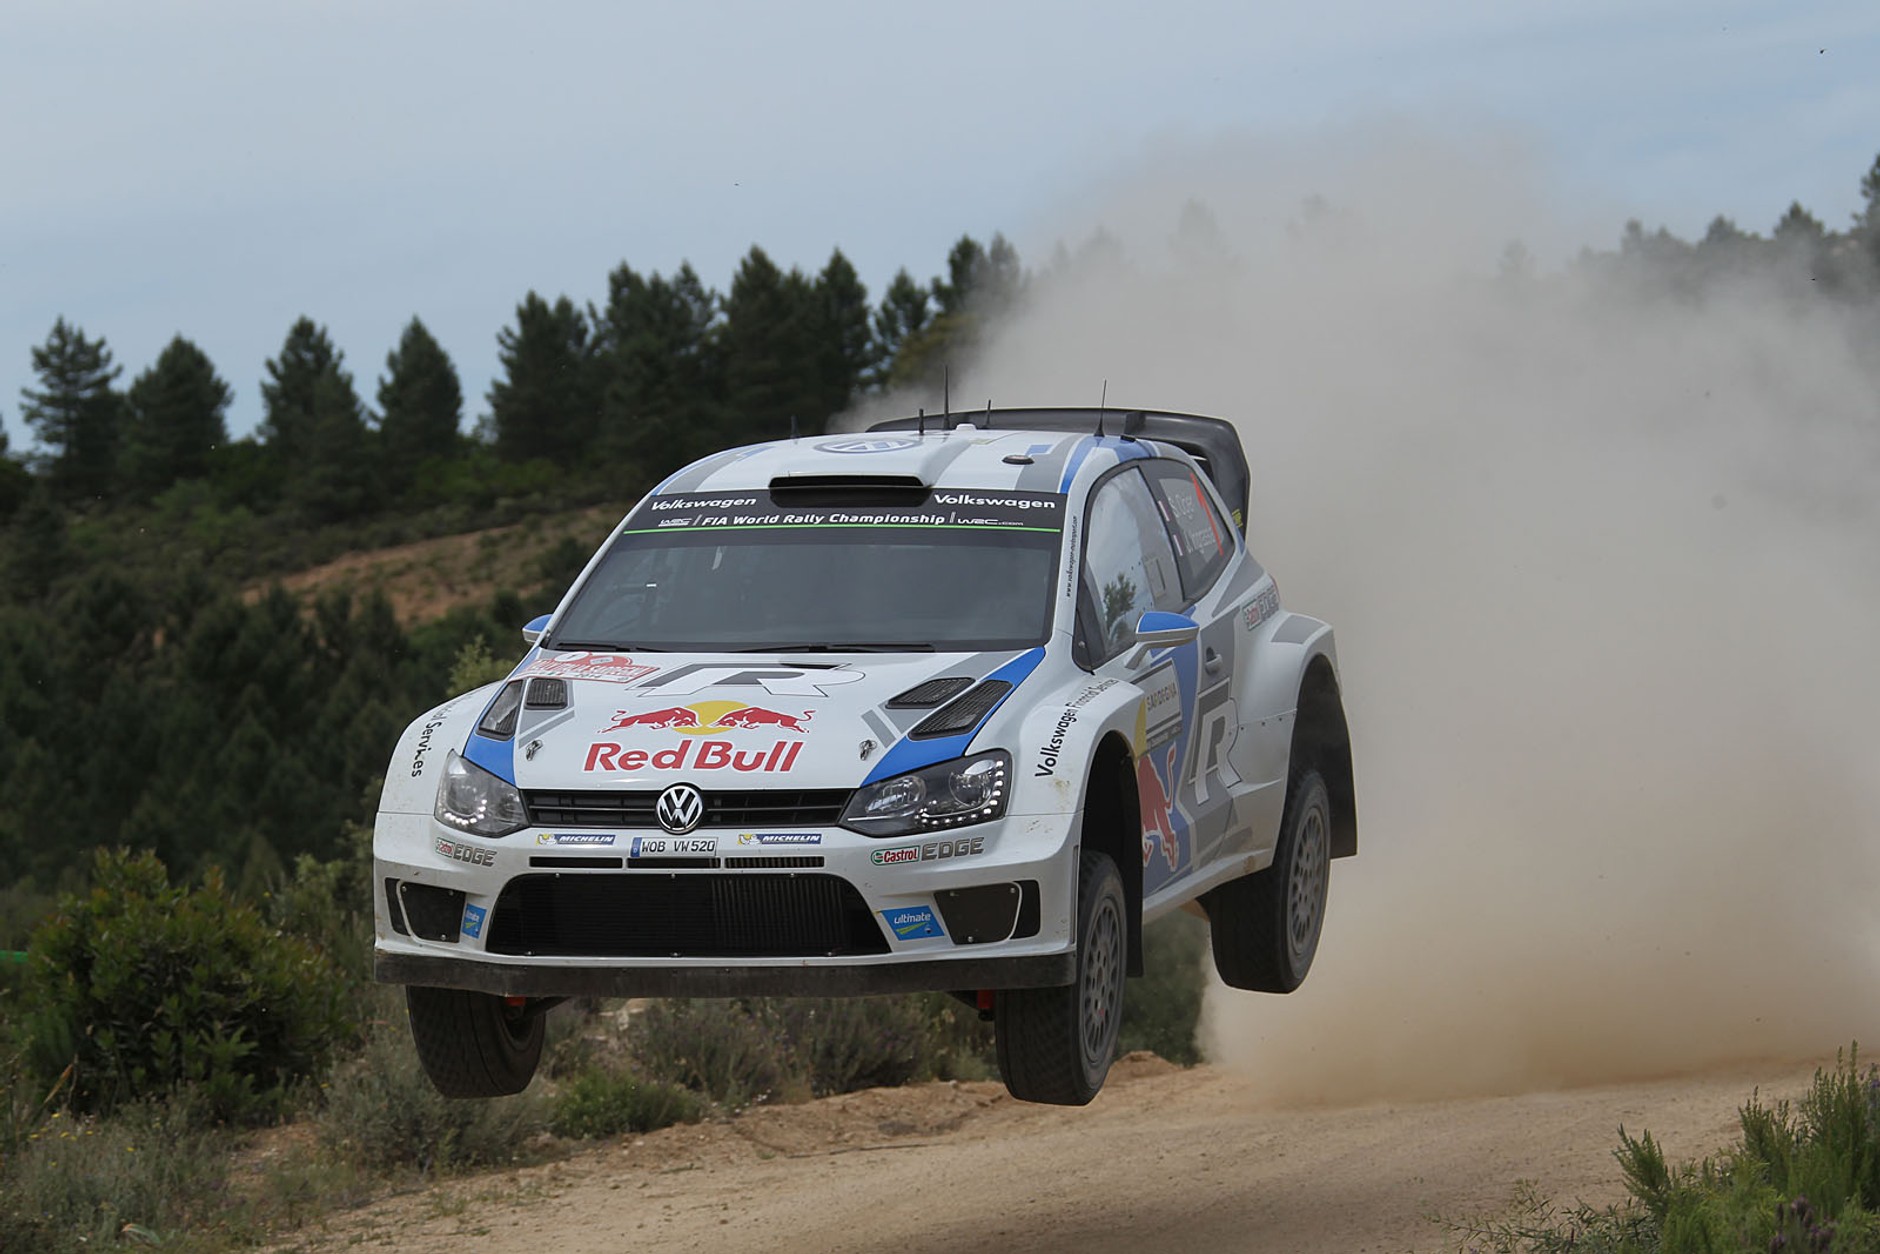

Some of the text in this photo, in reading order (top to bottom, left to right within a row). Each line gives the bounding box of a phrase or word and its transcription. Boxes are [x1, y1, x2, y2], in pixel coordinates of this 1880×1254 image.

[651, 498, 757, 511] Volkswagen
[934, 494, 1056, 509] Volkswagen
[701, 516, 727, 526] FIA
[733, 514, 780, 525] World
[783, 514, 825, 525] Rally
[829, 513, 945, 525] Championship
[583, 740, 804, 772] Red Bull
[558, 835, 614, 843] MICHELIN
[762, 834, 821, 843] MICHELIN
[642, 841, 666, 852] WOB
[674, 840, 690, 852] VW
[690, 840, 716, 852] 520
[884, 837, 985, 863] Castrol EDGE
[453, 843, 497, 867] EDGE
[894, 911, 931, 924] ultimate
